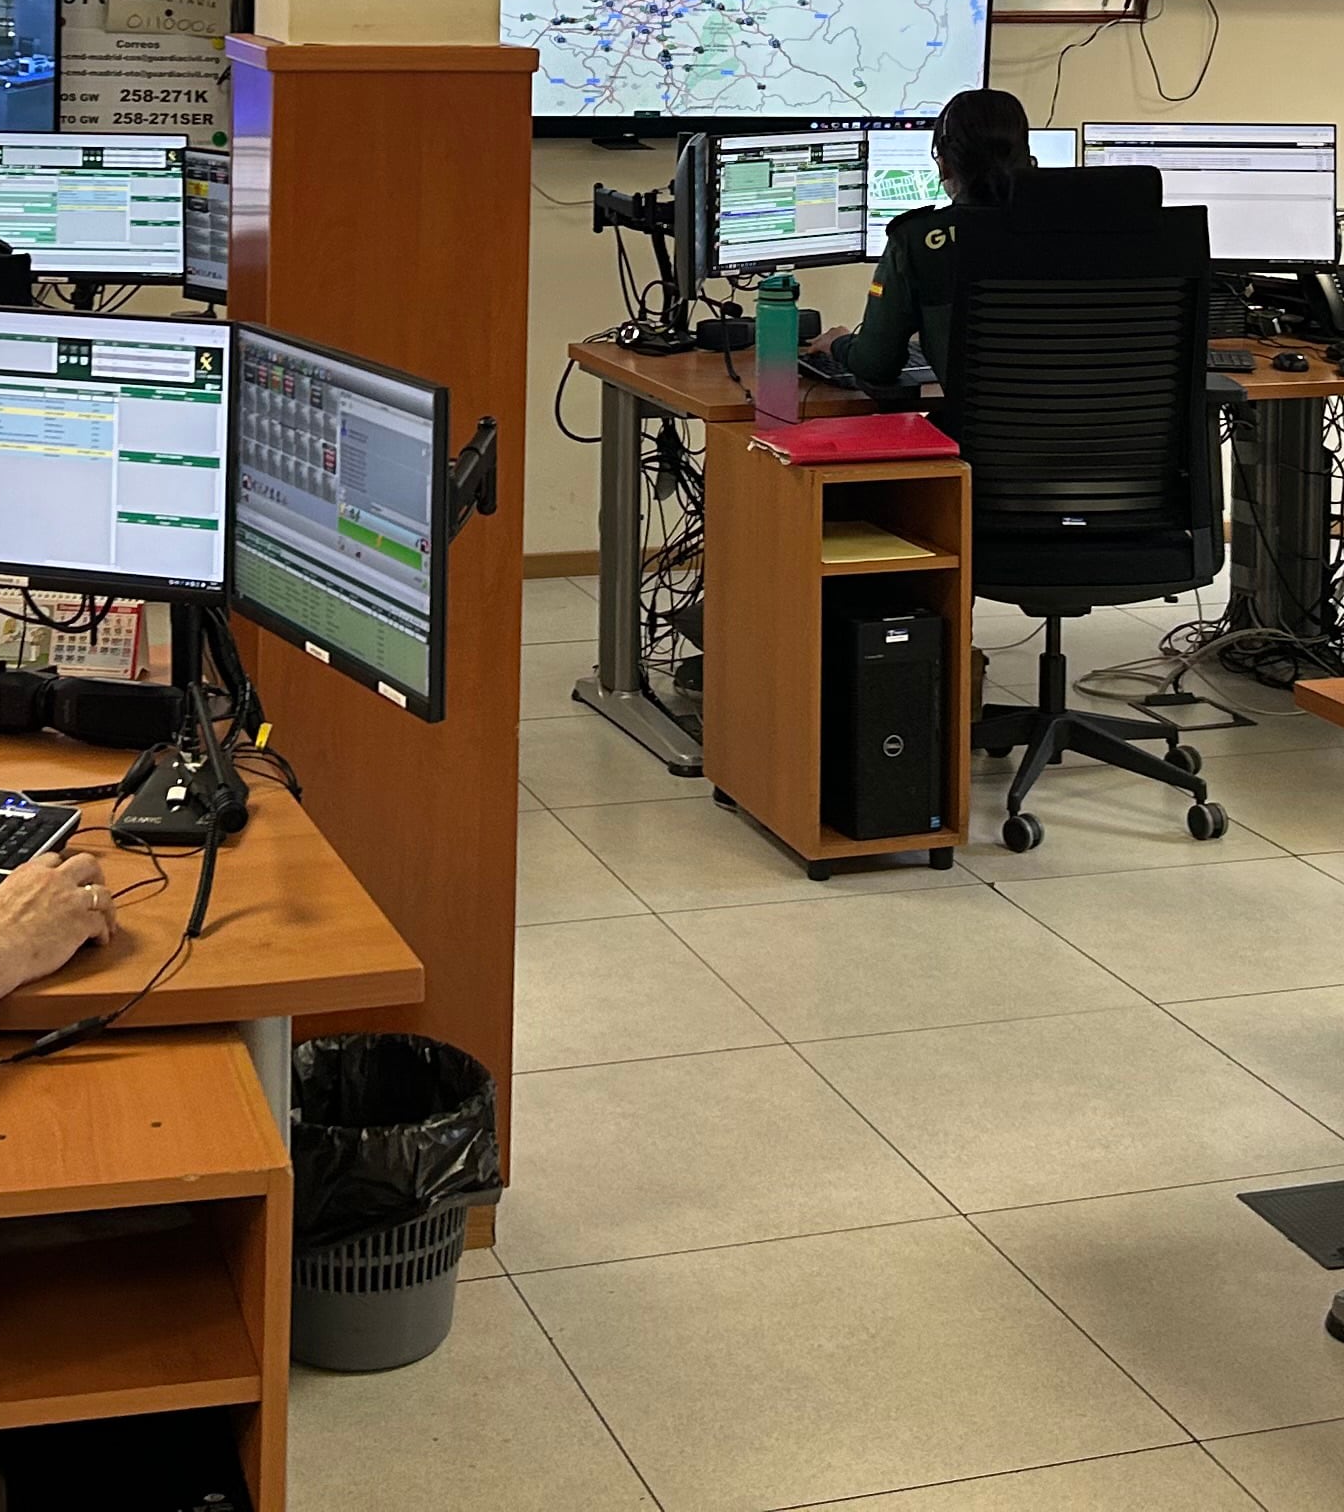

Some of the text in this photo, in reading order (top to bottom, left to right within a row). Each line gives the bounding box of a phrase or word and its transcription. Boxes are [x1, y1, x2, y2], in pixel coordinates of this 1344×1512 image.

[116, 39, 160, 50] Correos
[80, 93, 100, 103] GW
[119, 89, 209, 104] 258-271K
[80, 114, 99, 125] GW
[112, 112, 214, 126] 258-271SER
